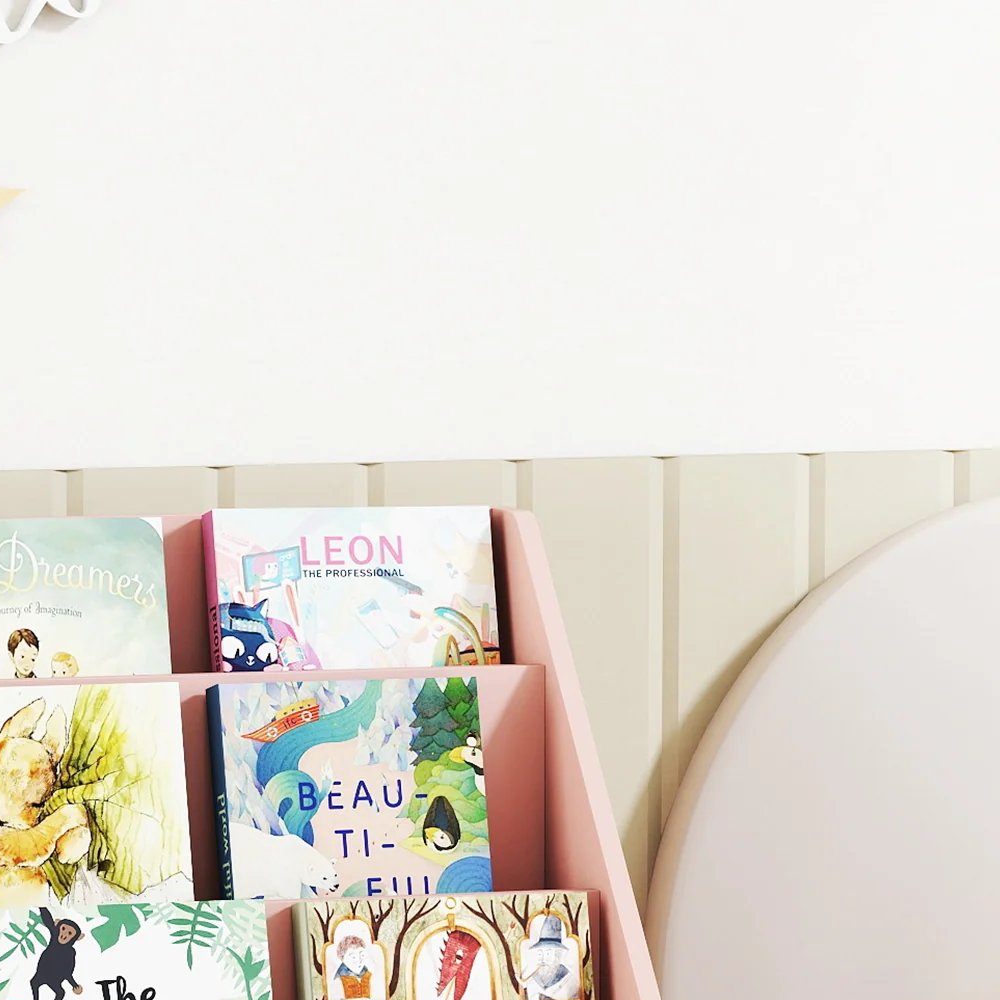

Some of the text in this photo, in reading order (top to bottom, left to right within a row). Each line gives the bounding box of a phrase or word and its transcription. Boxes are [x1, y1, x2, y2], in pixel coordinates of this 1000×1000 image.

[300, 535, 404, 566] LEON
[302, 567, 405, 579] THE PROFESSIONAL
[23, 602, 33, 614] of
[35, 601, 82, 618] Imagination
[334, 829, 395, 858] TI-
